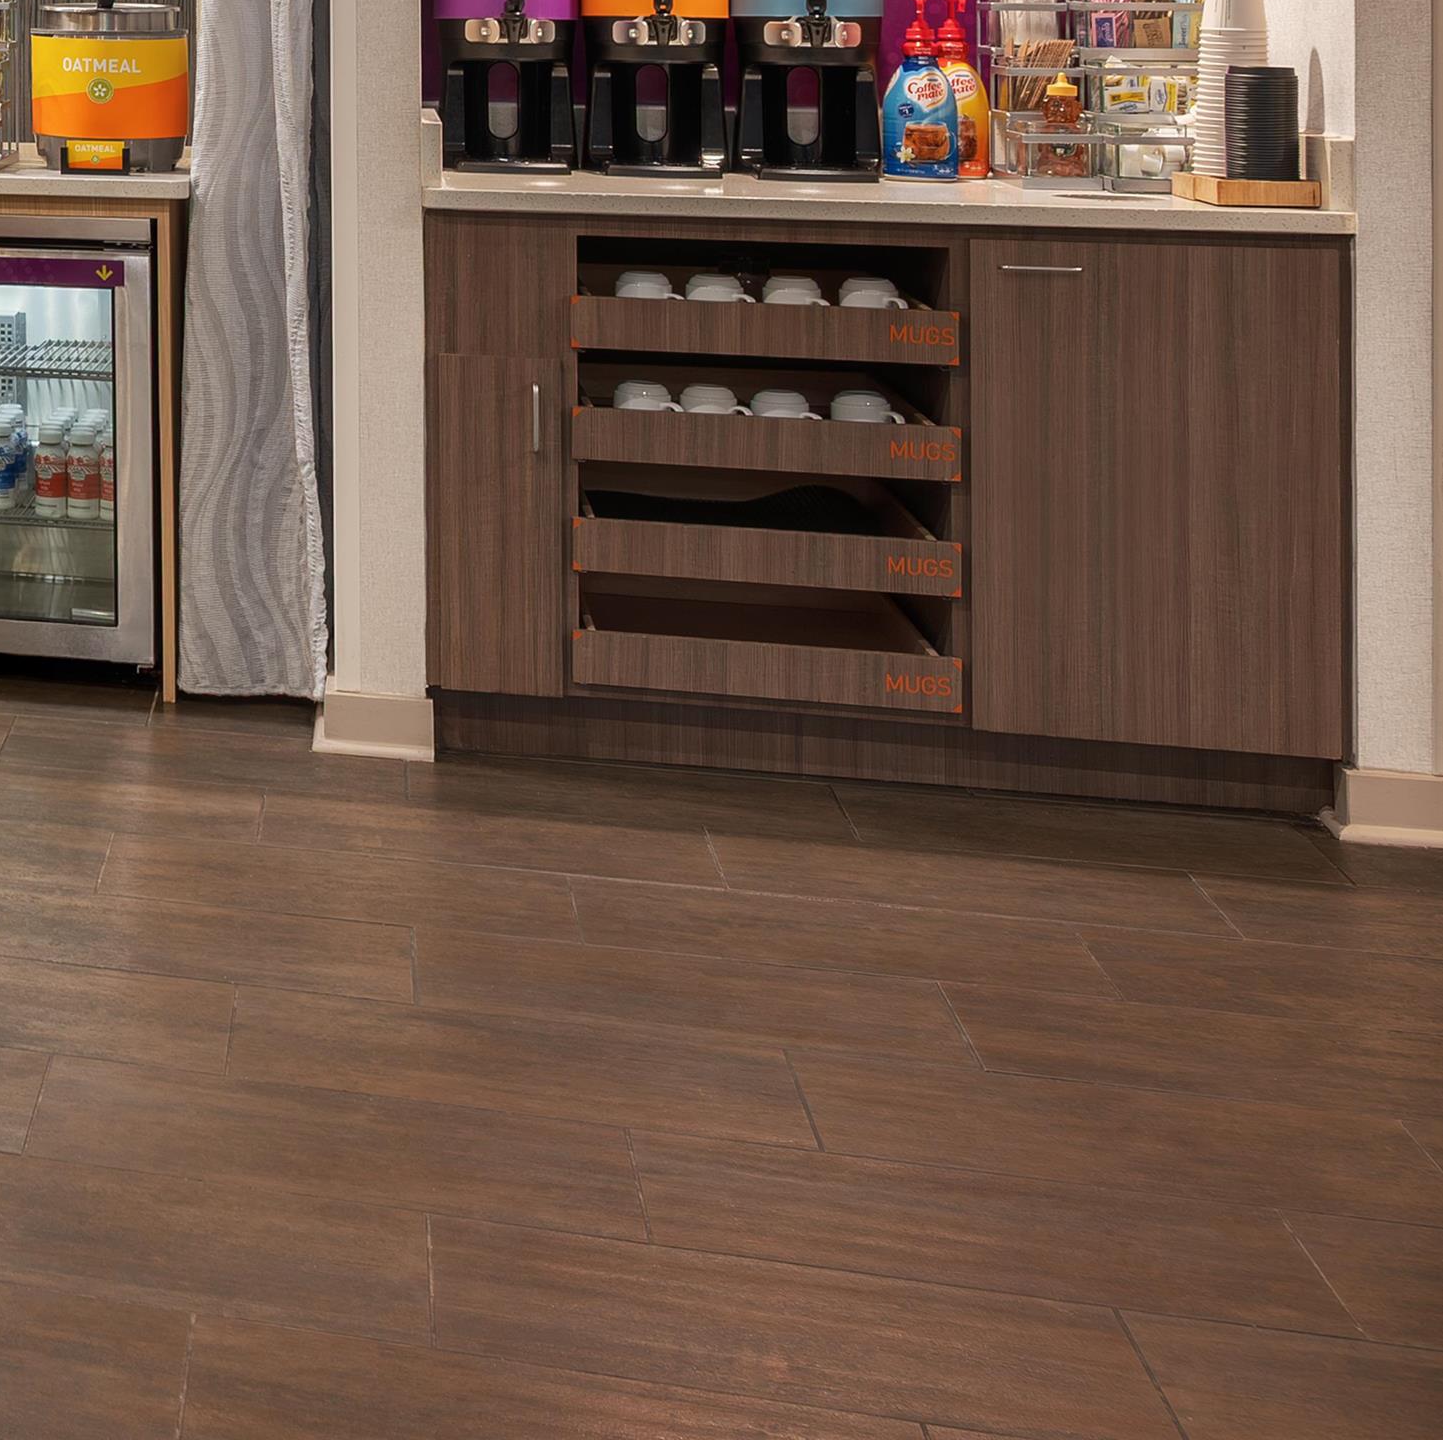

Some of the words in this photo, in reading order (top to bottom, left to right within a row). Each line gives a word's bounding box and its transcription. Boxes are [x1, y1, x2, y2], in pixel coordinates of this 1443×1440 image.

[62, 57, 141, 73] OATMEAL
[907, 81, 943, 95] Coffee
[950, 78, 975, 87] ffee
[917, 87, 945, 101] mate
[74, 144, 115, 152] OATMEAL
[889, 323, 955, 346] MUGS
[889, 439, 955, 462] MUGS
[887, 555, 954, 578] MUGS
[885, 673, 952, 697] MUGS
